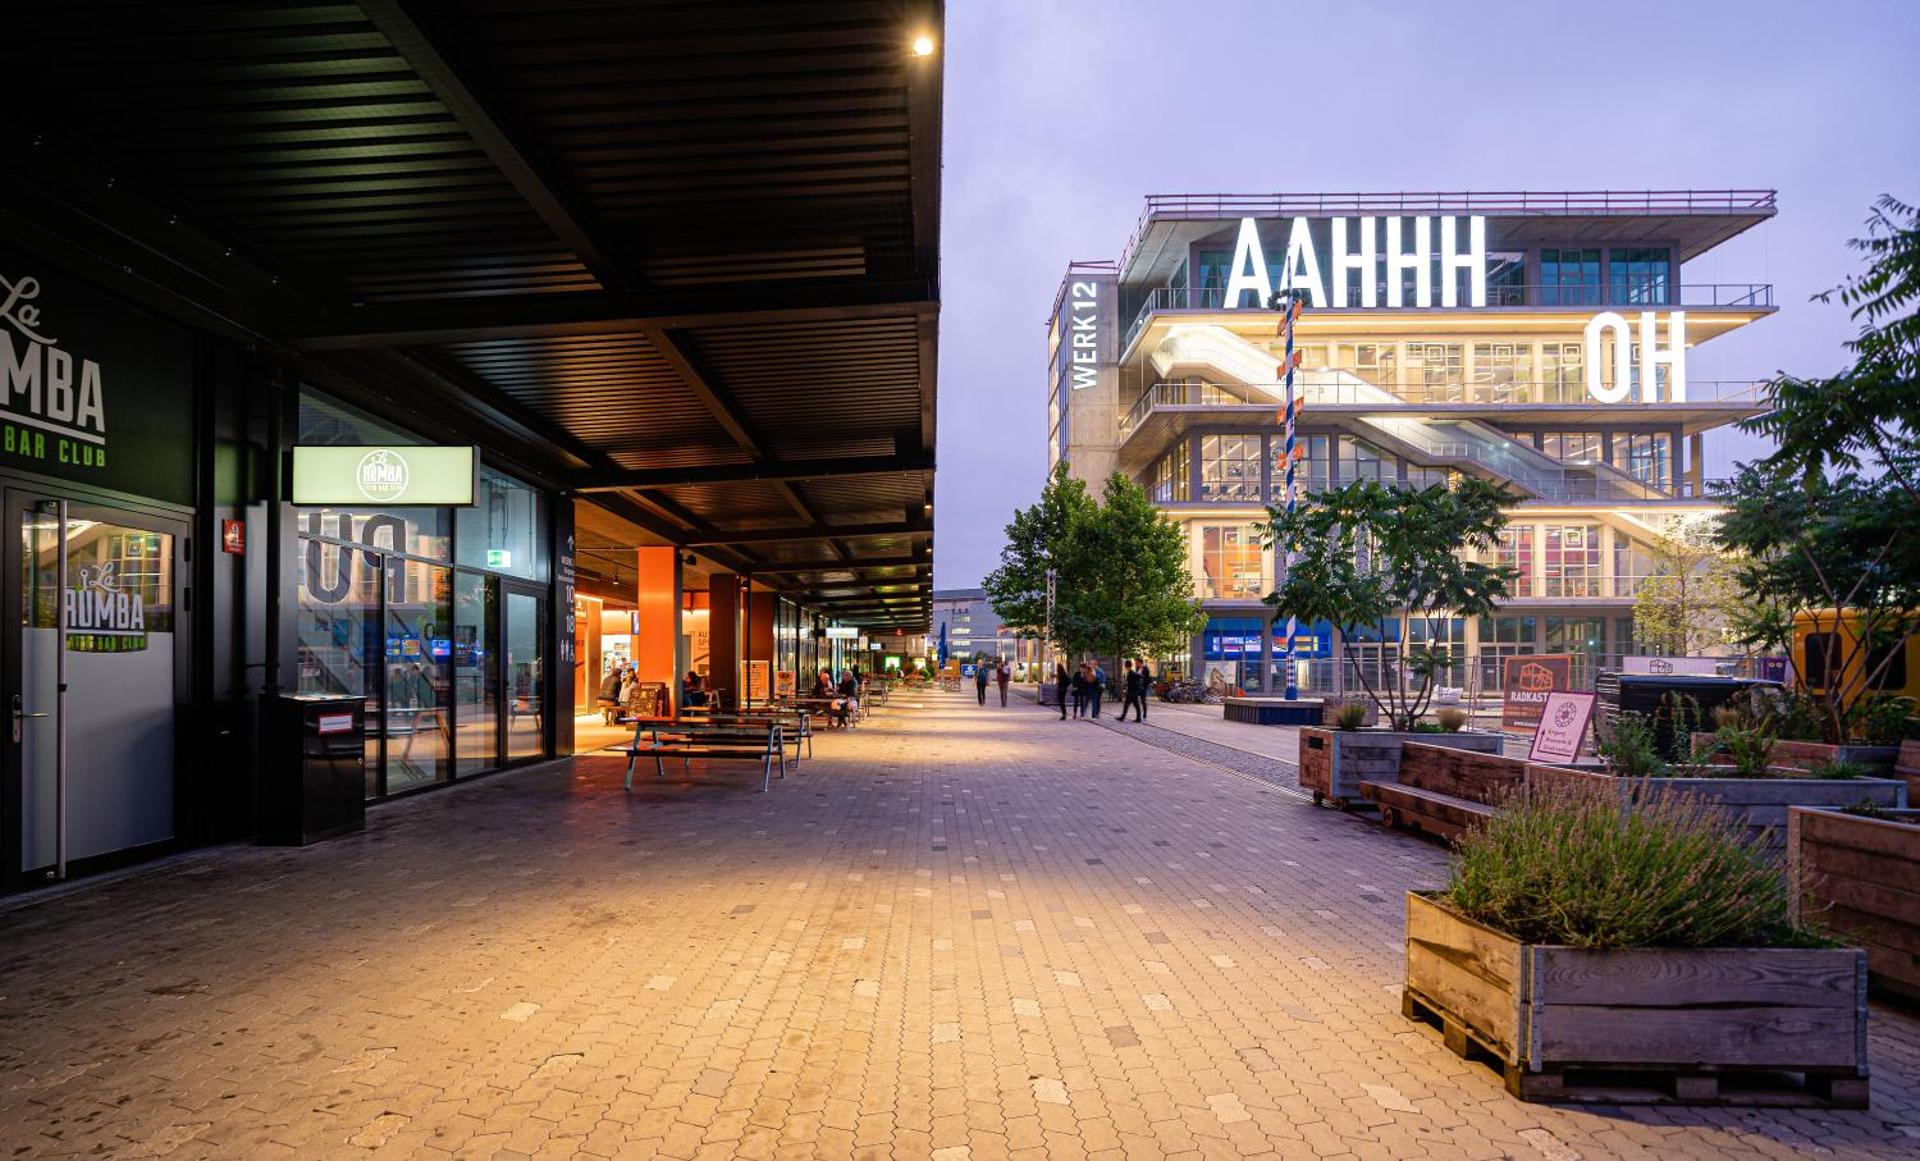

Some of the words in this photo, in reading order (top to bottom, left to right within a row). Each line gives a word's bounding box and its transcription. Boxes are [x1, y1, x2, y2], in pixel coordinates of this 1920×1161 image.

[1223, 216, 1486, 308] AAHHH
[0, 276, 57, 345] La
[1584, 311, 1686, 403] OH
[4, 425, 45, 459] BAR
[59, 439, 105, 467] CLUB
[64, 589, 144, 630] RUMBA
